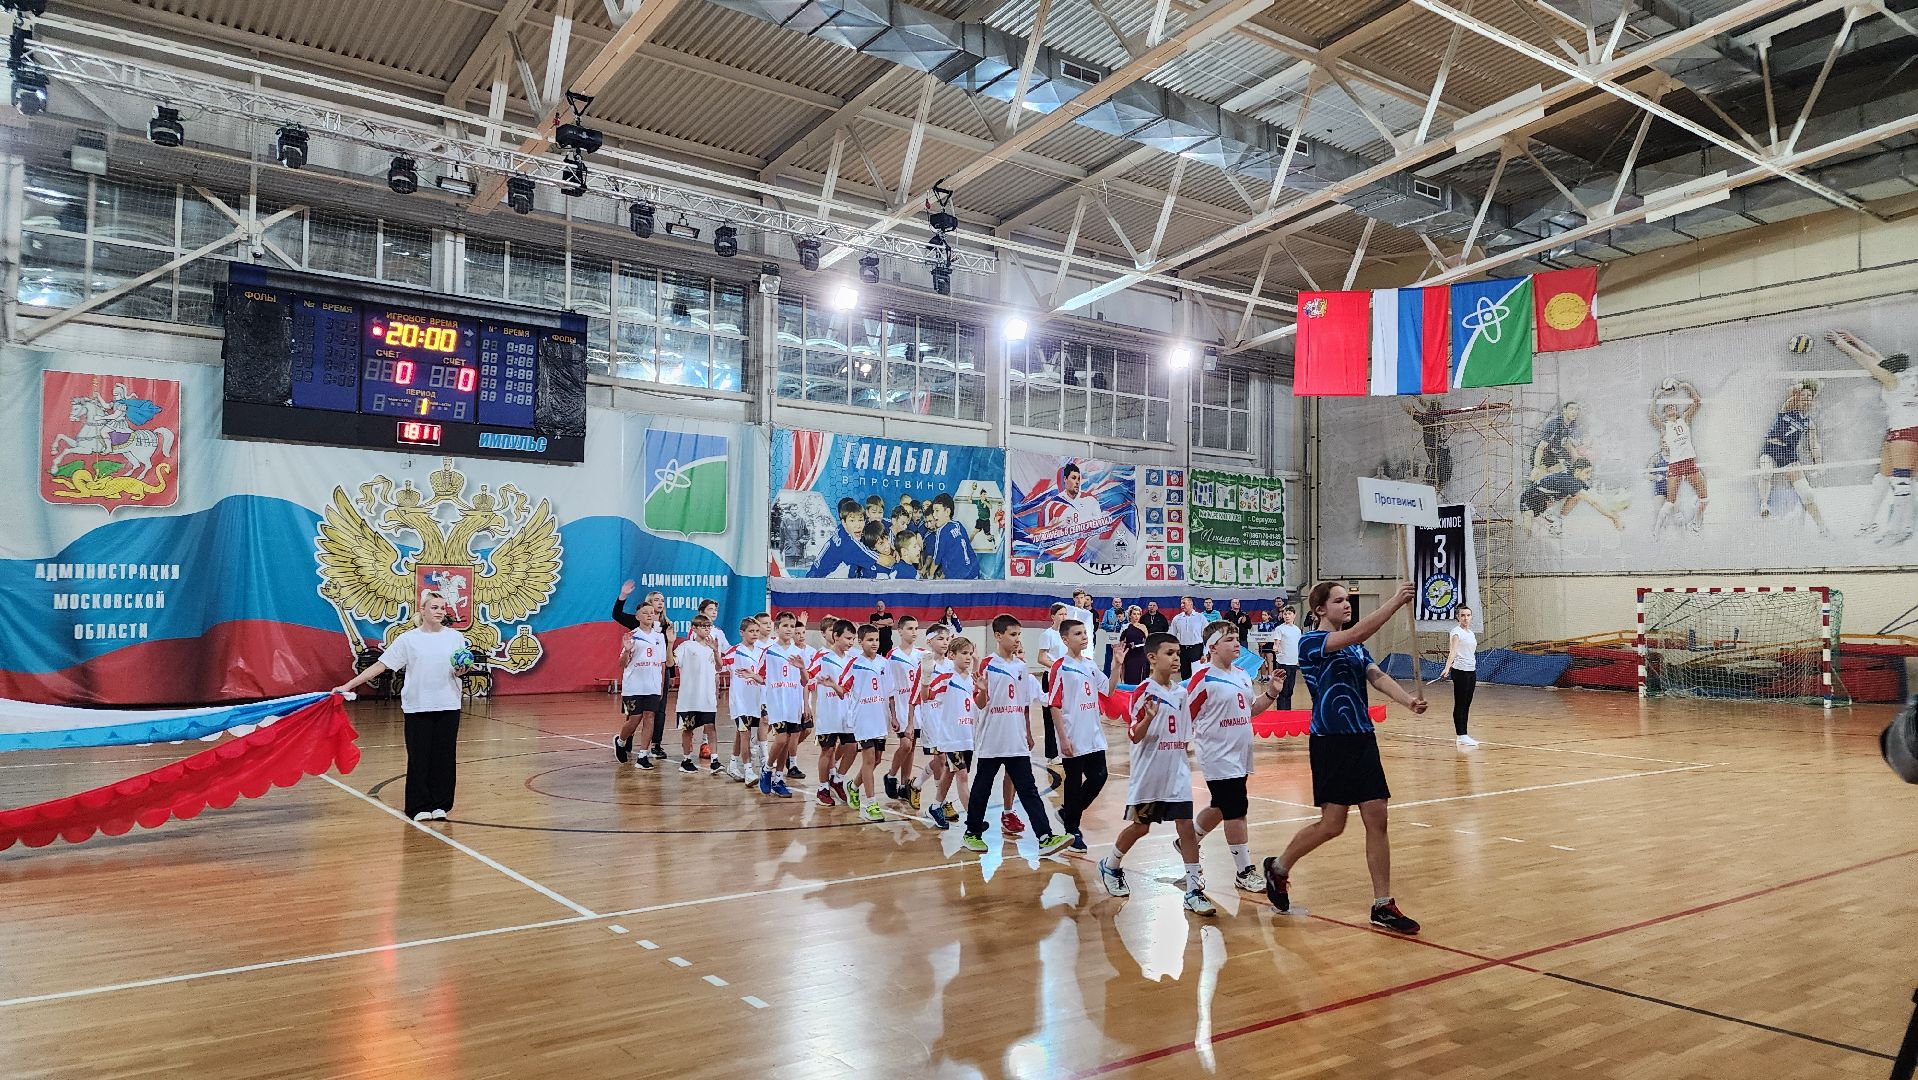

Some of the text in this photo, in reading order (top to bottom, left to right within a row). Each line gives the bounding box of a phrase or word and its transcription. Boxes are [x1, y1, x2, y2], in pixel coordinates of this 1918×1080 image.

[244, 291, 278, 303] ФОЛЫ
[322, 302, 353, 314] ВРЕМЯ
[386, 311, 459, 329] ИГРОВОЕ ВРЕМЯ
[385, 321, 457, 353] 20:00
[503, 327, 530, 338] ВРЕМЯ
[551, 334, 577, 344] ФОЛЫ
[395, 360, 415, 385] 0
[457, 367, 477, 393] 0
[405, 388, 437, 399] ПЕРИОД
[478, 432, 548, 453] ИМПУЛЬС
[842, 441, 949, 477] ГАНДБОЛ
[1374, 492, 1417, 508] Протвино
[1433, 534, 1447, 569] 3
[34, 562, 181, 582] АДМИНИСТРАЦИЯ
[641, 573, 728, 588] АДМИНИСТРАЦИЯ
[53, 590, 165, 610] МОСКОВСКОЙ
[74, 622, 148, 640] ОБЛАСТИ
[1237, 692, 1246, 711] 8
[1168, 714, 1178, 735] 8
[1219, 715, 1249, 728] КОМАНДА
